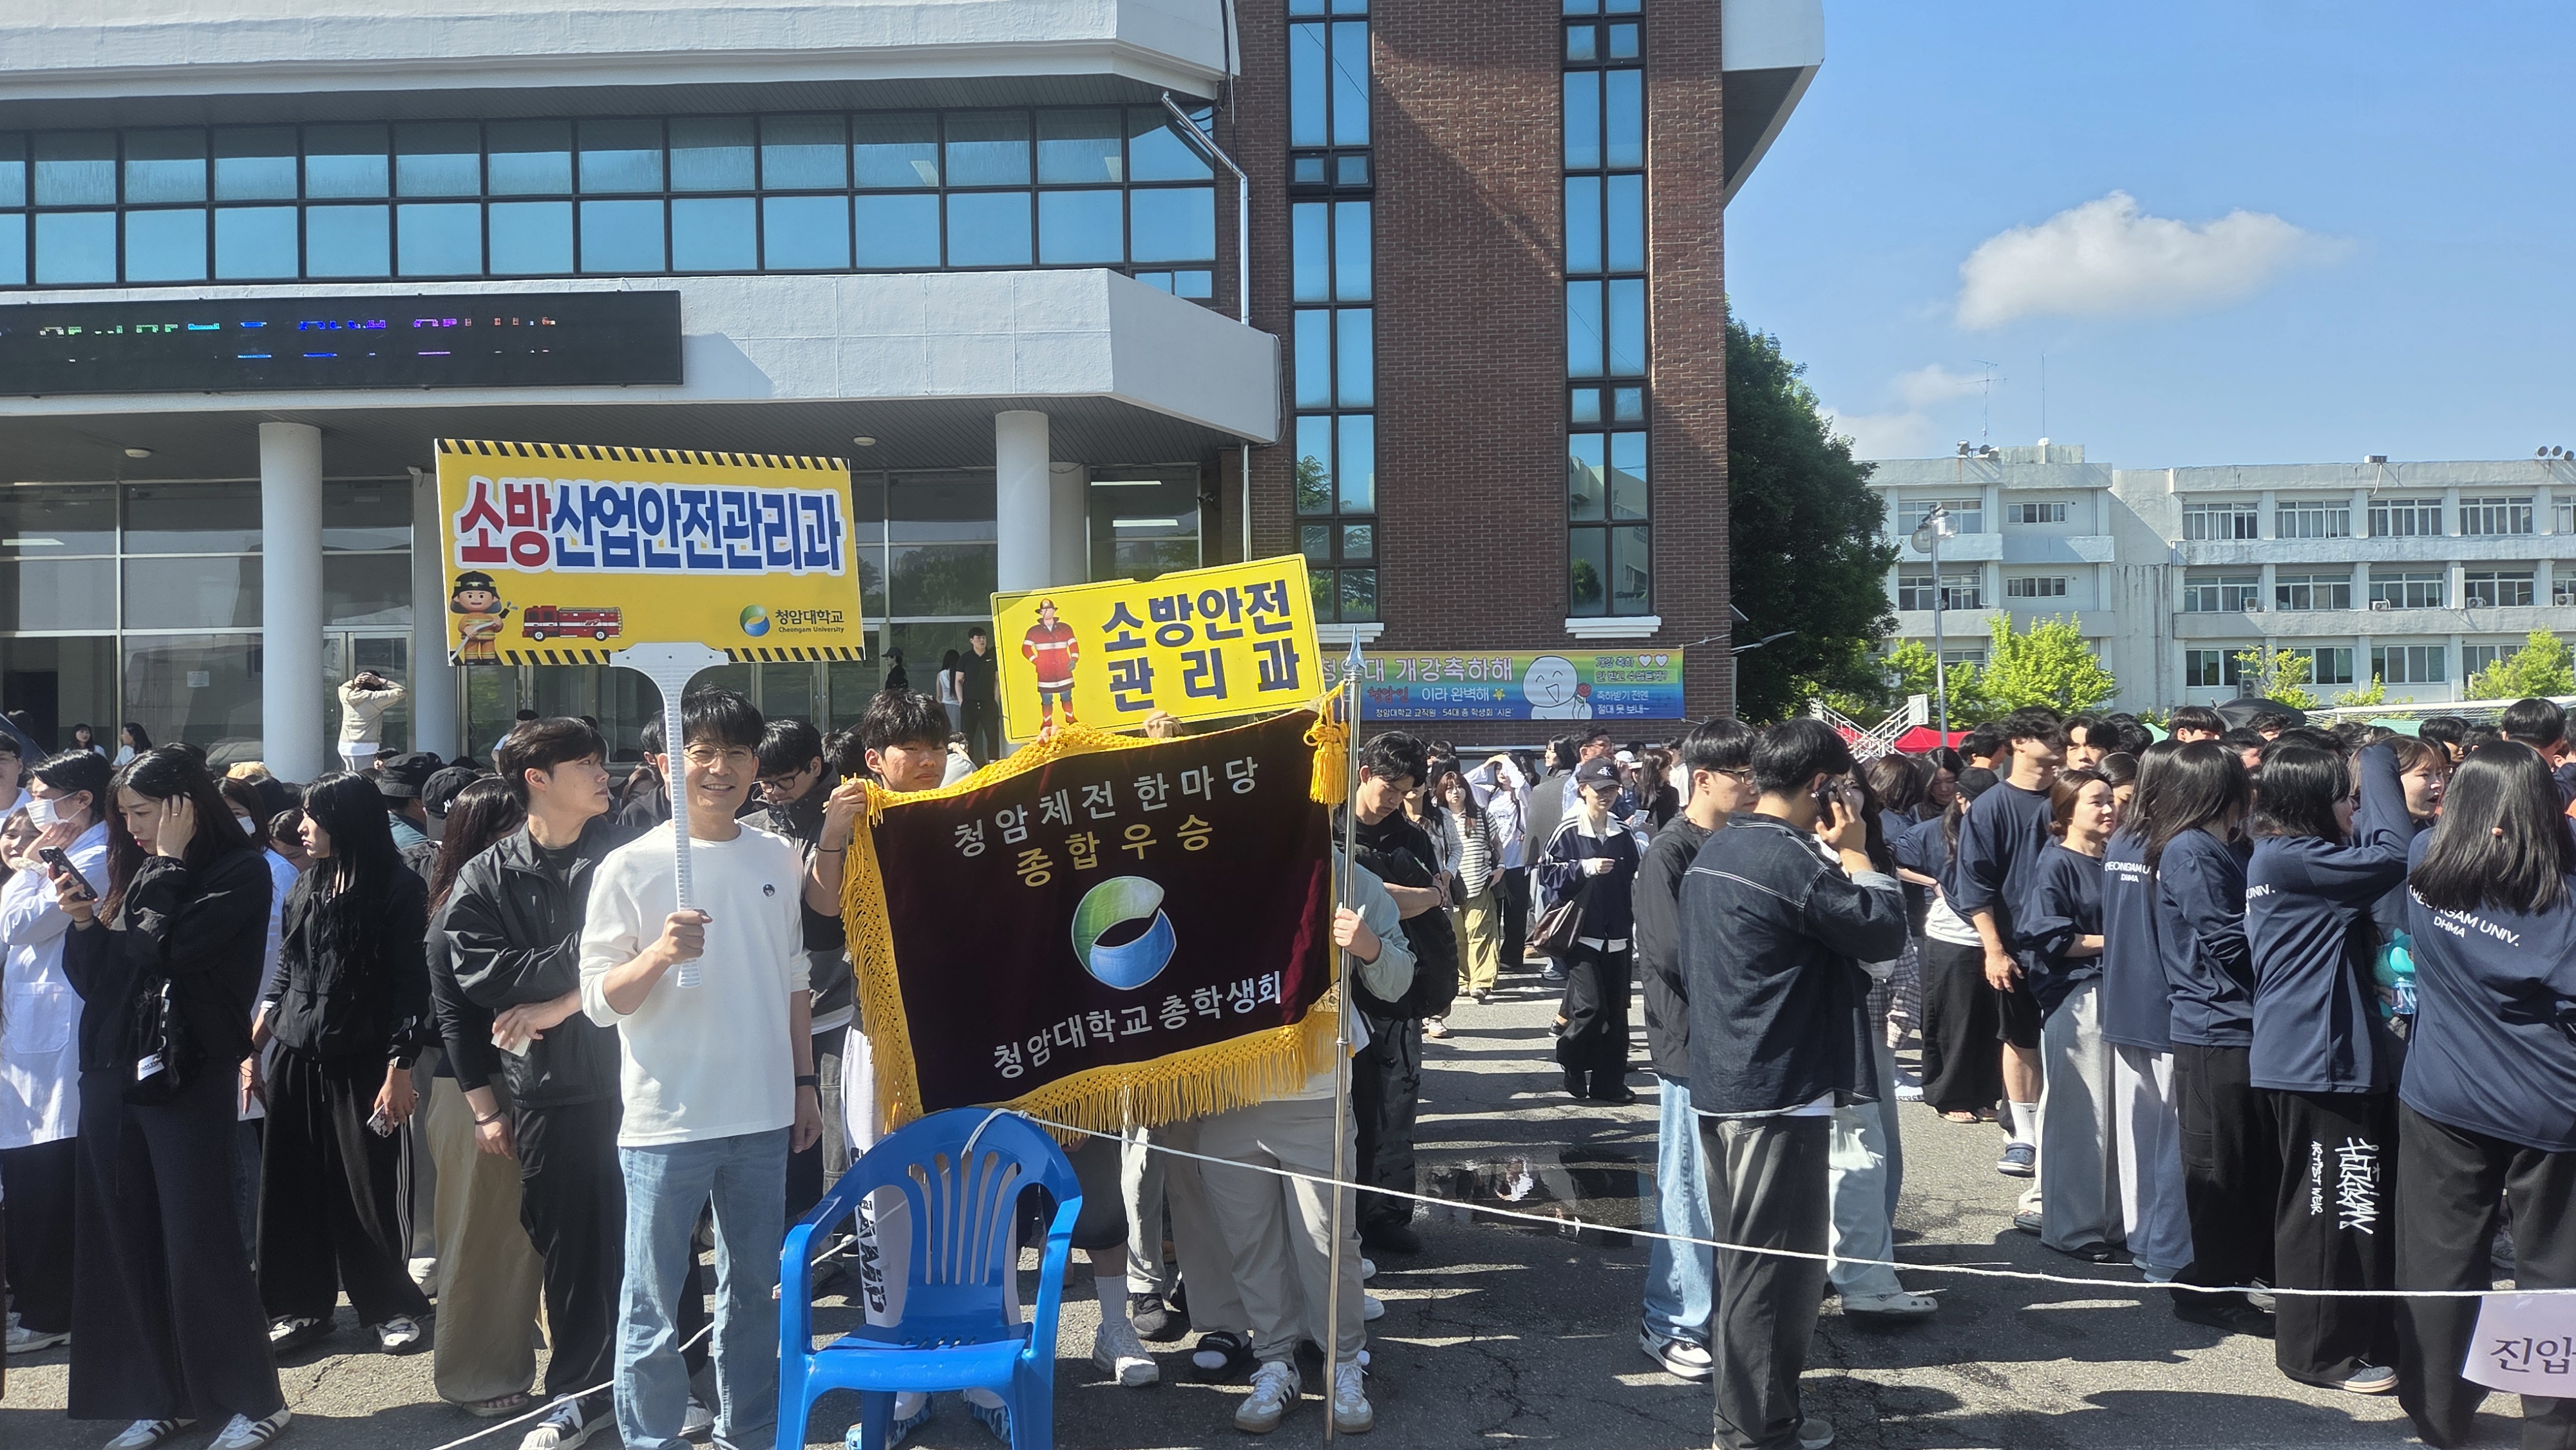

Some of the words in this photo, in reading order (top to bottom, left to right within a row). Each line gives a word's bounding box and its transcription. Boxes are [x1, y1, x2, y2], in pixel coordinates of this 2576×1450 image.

[460, 482, 841, 570] 소방산업안전관리과
[775, 609, 844, 625] 청암대학교
[1101, 579, 1293, 653] 소방안전
[1596, 656, 1614, 668] 개강
[1616, 656, 1634, 668] 축하
[1367, 685, 1408, 703] 청암인
[1421, 687, 1448, 702] 이라
[1450, 687, 1490, 702] 완벽해
[1596, 690, 1630, 701] 축하받기
[1376, 708, 1412, 717] 청암대학교
[1414, 708, 1436, 717] 교직원
[1597, 704, 1614, 715] 절대
[1616, 704, 1625, 714] 못
[954, 785, 1117, 858] 청암체전
[1133, 756, 1259, 812] 한마당
[2433, 916, 2466, 939] DHMA
[2479, 919, 2520, 947] UNIV.
[994, 1006, 1153, 1079] 청암대학교
[1159, 971, 1282, 1030] 총학생회
[2311, 1140, 2324, 1186] ARTIST
[2311, 1187, 2324, 1216] WEAR
[2490, 1337, 2576, 1374] 진입
